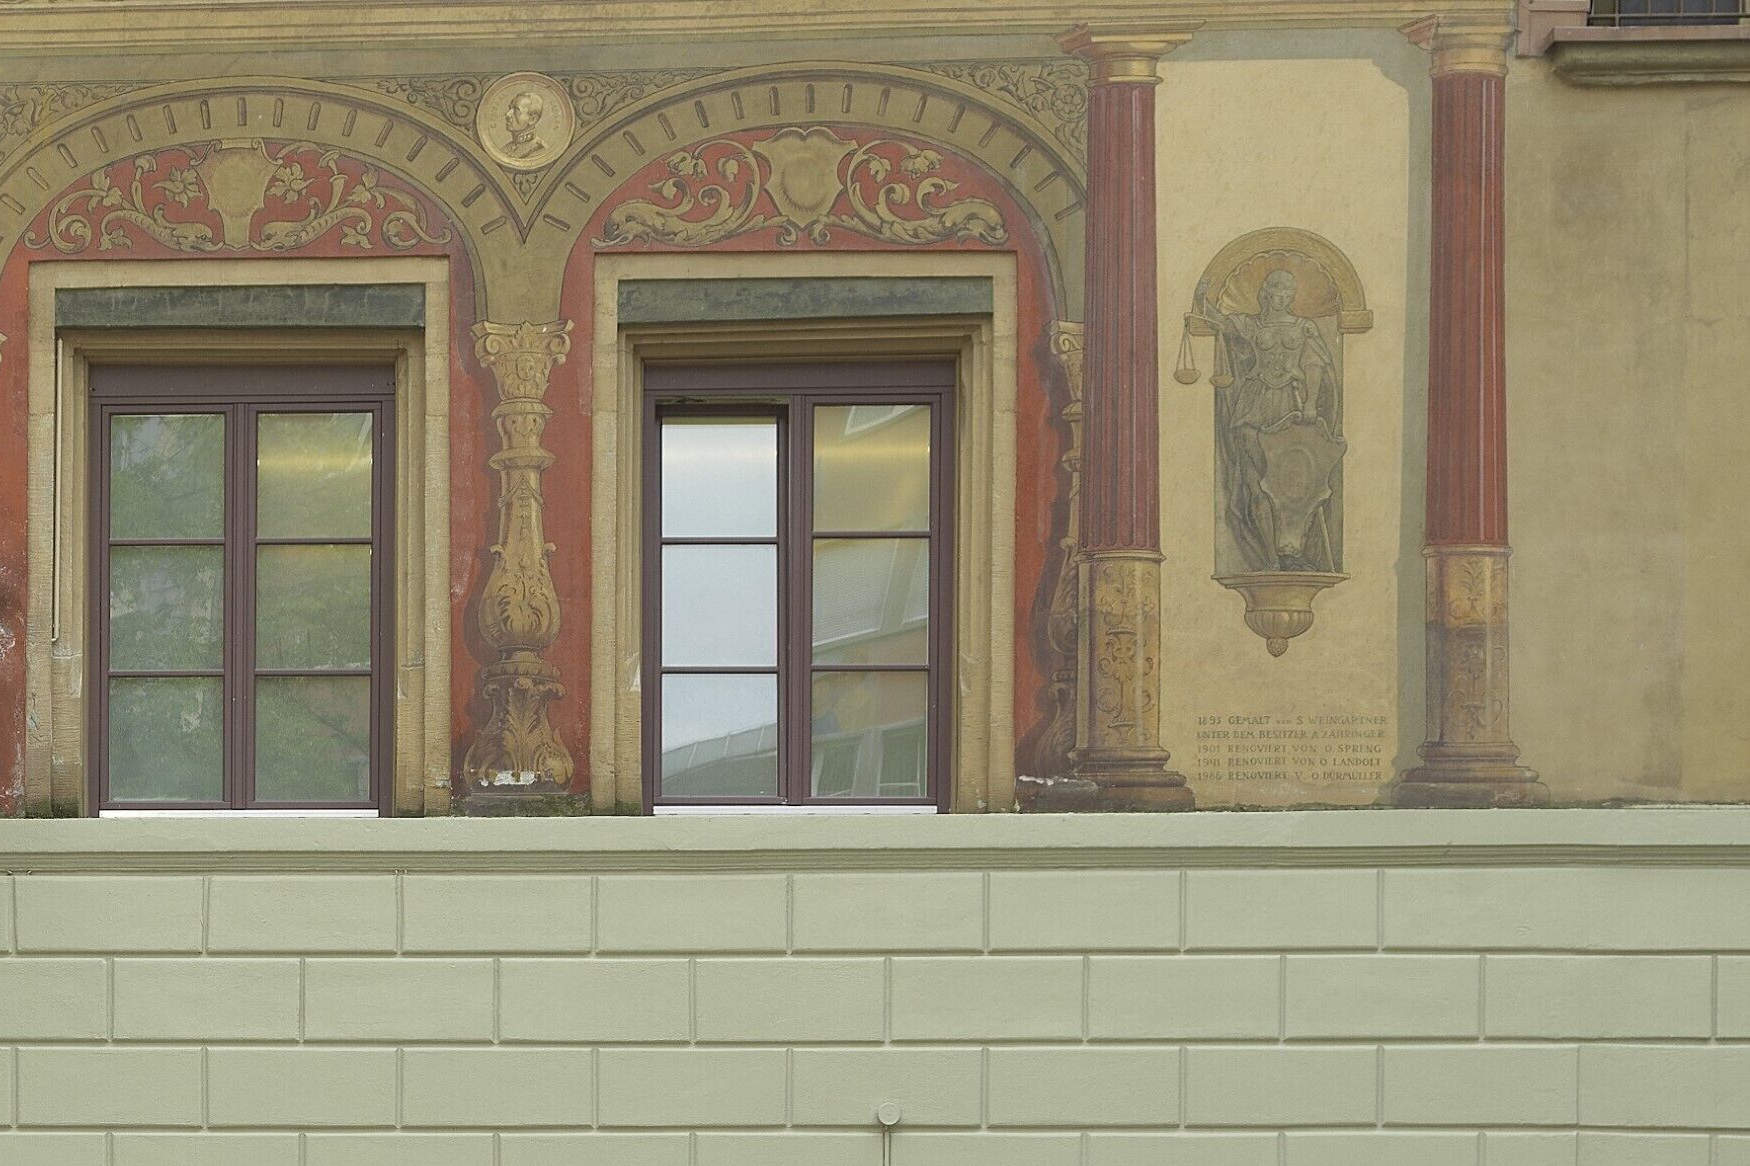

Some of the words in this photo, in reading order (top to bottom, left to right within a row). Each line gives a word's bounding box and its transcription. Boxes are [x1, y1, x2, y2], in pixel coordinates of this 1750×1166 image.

[1228, 716, 1271, 724] GEMALT
[1197, 730, 1230, 739] UNTER
[1259, 730, 1307, 739] BESITZER
[1197, 744, 1220, 753] 1901
[1227, 744, 1286, 753] RENOVIERT
[1292, 744, 1316, 753] VON
[1338, 744, 1381, 753] SPRENG
[1227, 757, 1286, 766] RENOVIERT
[1292, 757, 1315, 766] VON
[1333, 757, 1381, 766] LANDOLT
[1227, 771, 1287, 780] RENOVIERT
